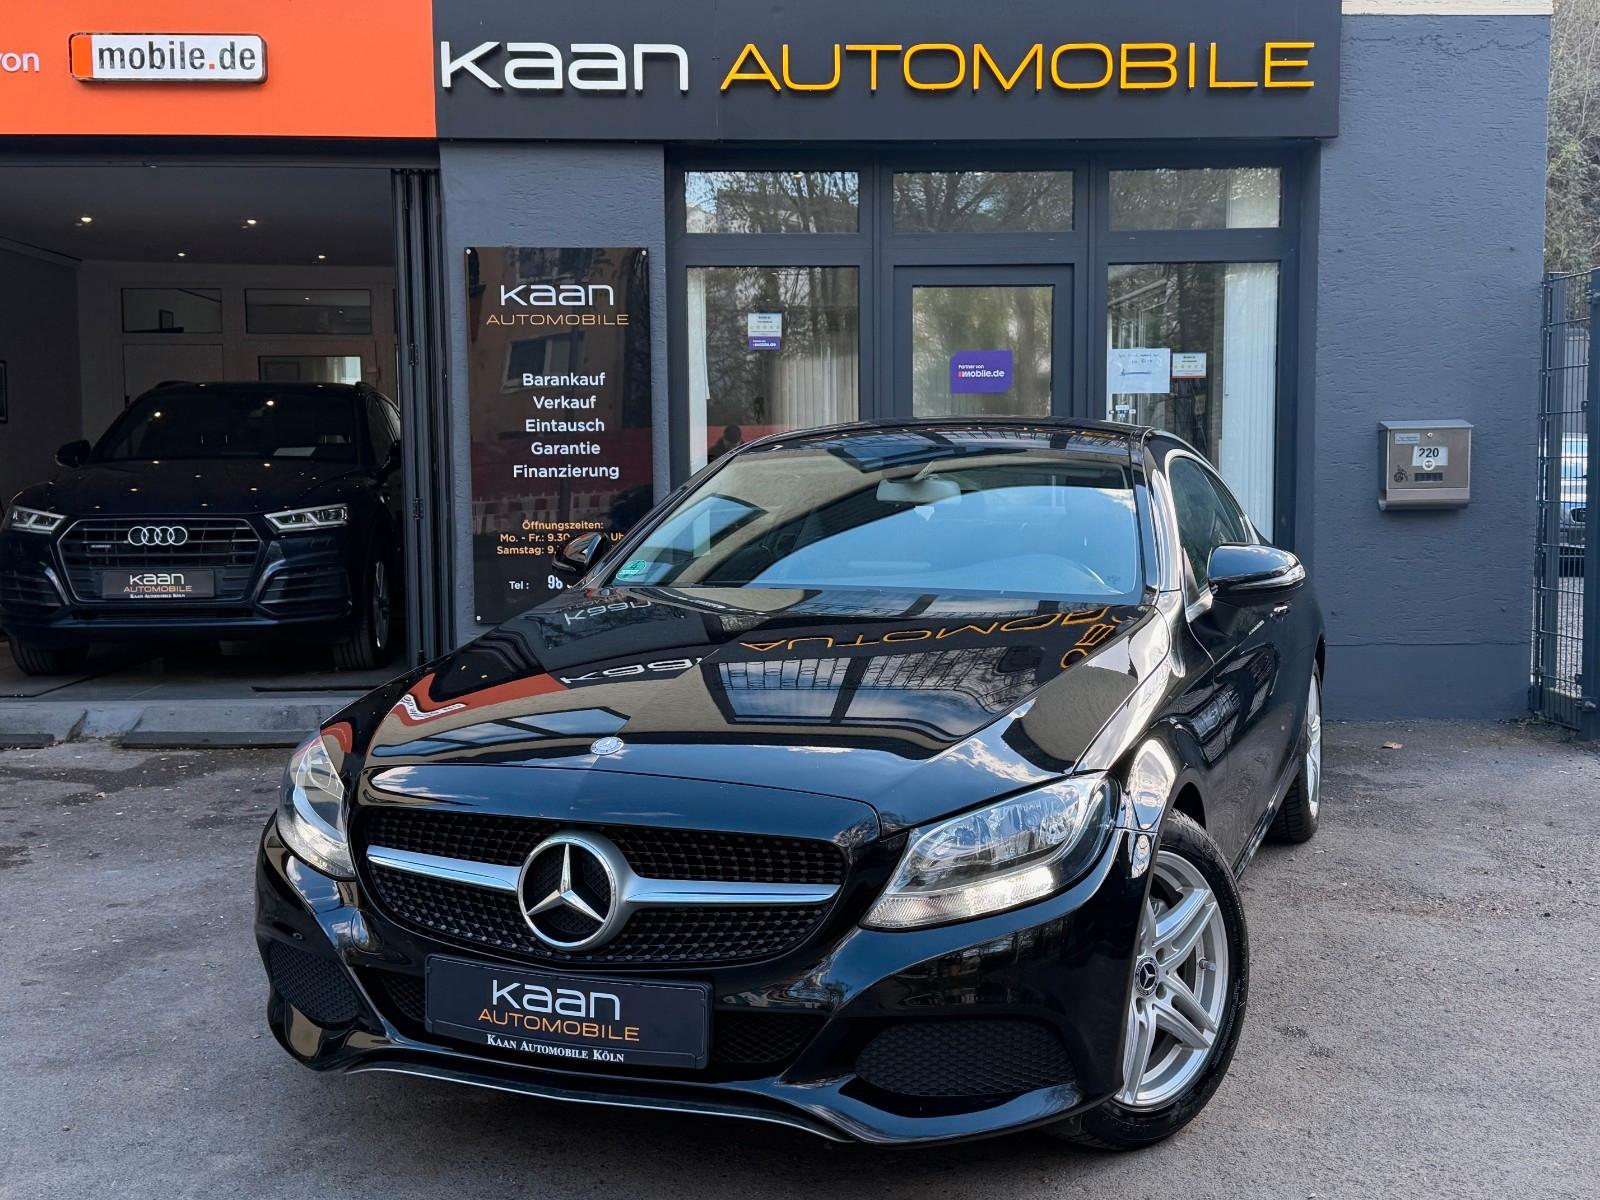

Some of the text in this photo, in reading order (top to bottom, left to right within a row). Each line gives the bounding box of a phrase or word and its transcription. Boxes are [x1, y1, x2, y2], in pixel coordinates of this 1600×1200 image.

[0, 40, 256, 72] on mobile.de
[720, 42, 1316, 92] AUTOMOBILE
[486, 314, 630, 326] AUTOMOBILE
[522, 372, 606, 386] Barankauf
[963, 369, 1005, 378] mobile.de
[533, 395, 597, 409] Verkauf
[525, 418, 605, 432] Eintausch
[531, 442, 601, 455] Garantie
[1418, 447, 1440, 458] 220
[513, 464, 620, 479] Finanzierung
[522, 519, 604, 531] Öffnungszeiten:
[500, 533, 519, 543] Mo.
[528, 533, 545, 542] Fr.:
[496, 545, 545, 556] Samstag:
[123, 585, 193, 593] AUTOMOBILE
[509, 580, 524, 590] Tel
[477, 1008, 640, 1042] AUTOMOBILE
